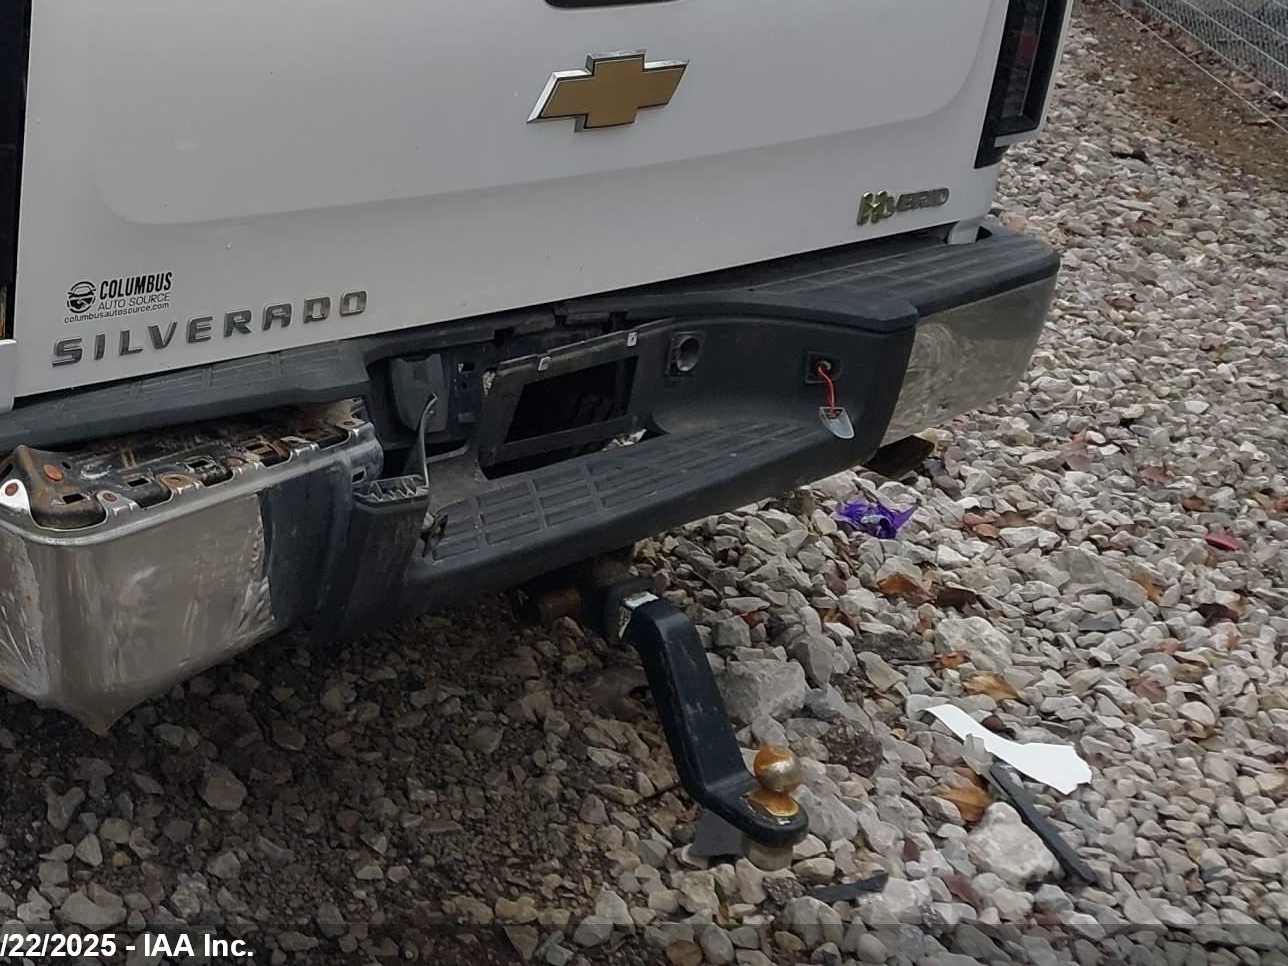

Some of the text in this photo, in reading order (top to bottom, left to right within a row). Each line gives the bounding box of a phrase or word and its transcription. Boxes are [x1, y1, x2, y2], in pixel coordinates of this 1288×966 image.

[99, 272, 173, 300] COLUMBUS
[64, 302, 170, 324] columbusautosource.com
[97, 292, 171, 311] AUTO SOURCE
[51, 290, 368, 367] SILVERADO
